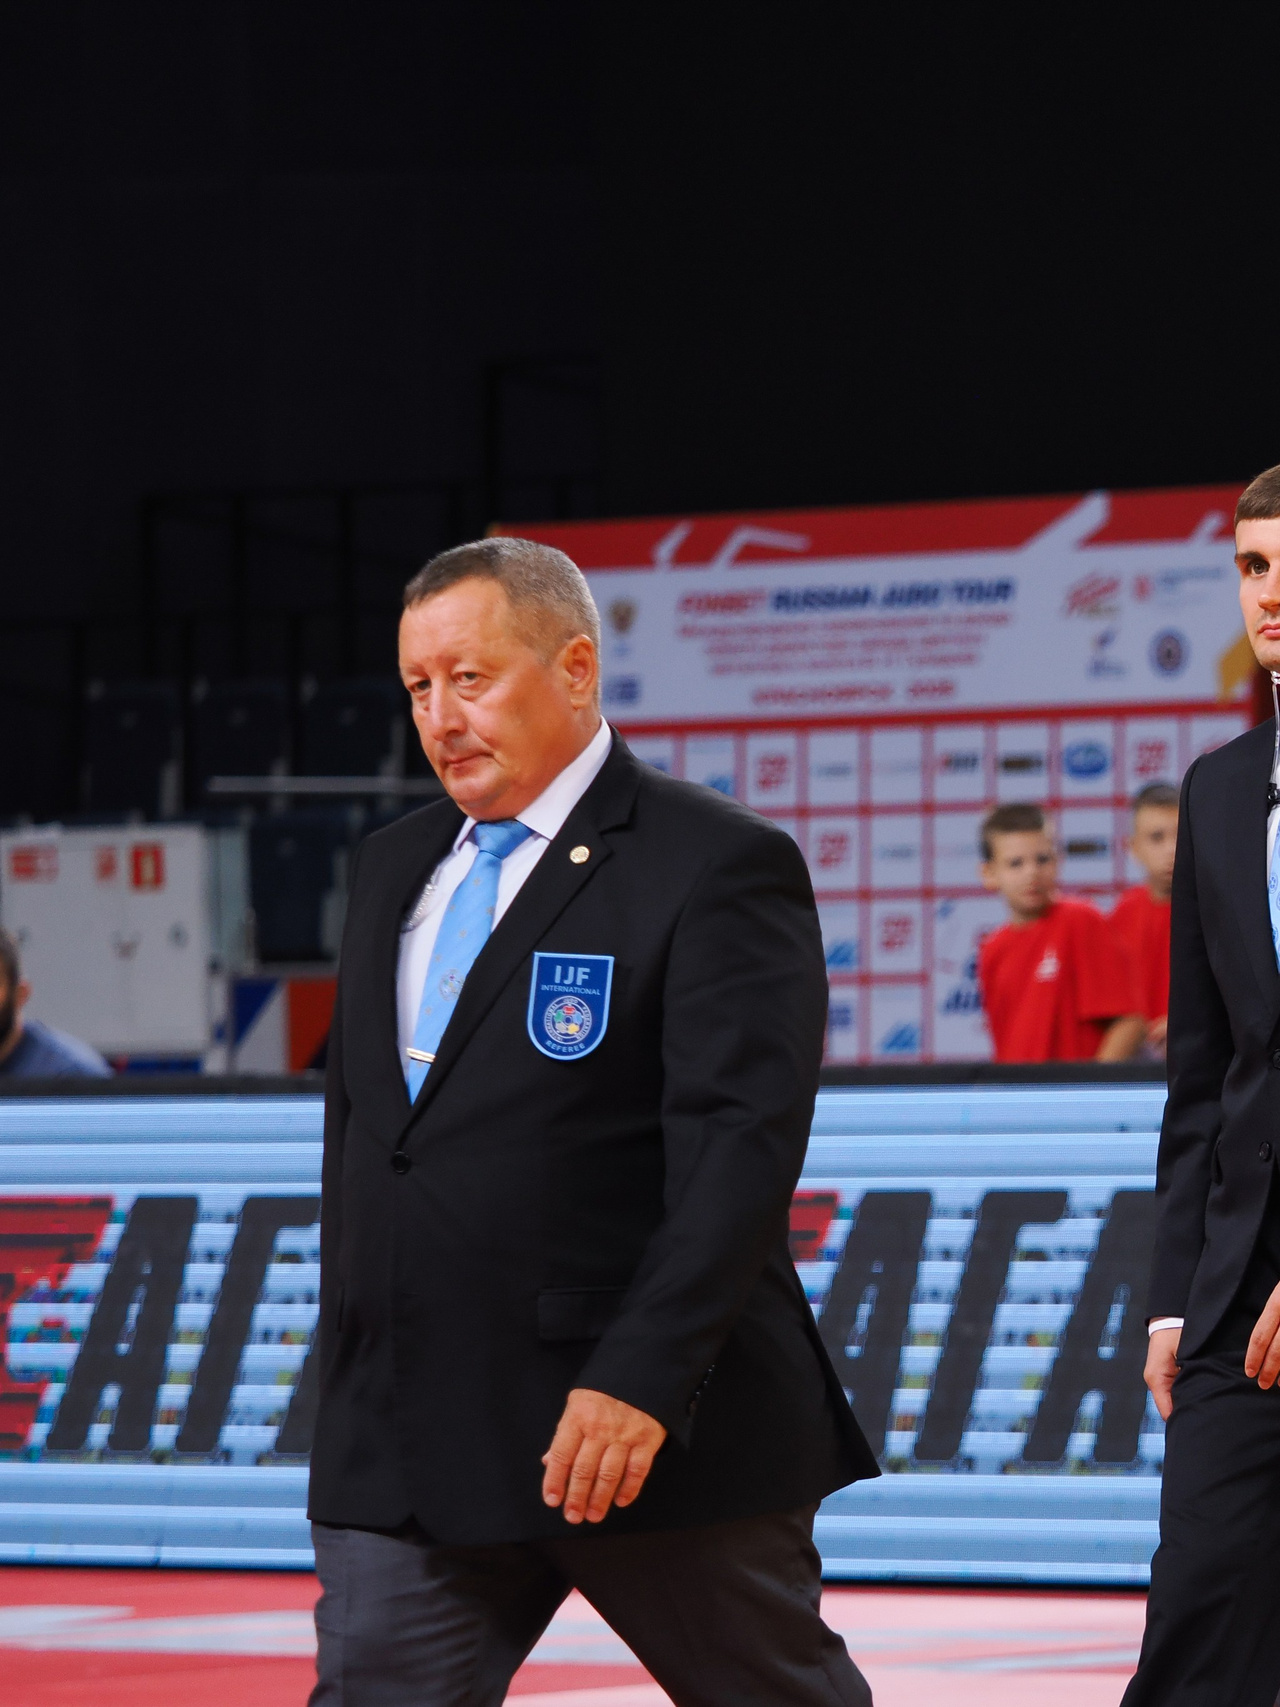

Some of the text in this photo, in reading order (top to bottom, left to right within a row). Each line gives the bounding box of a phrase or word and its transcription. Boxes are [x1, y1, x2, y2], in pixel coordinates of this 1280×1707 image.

[554, 965, 591, 986] IJF
[541, 984, 601, 996] INTERNATIONAL
[545, 1039, 586, 1053] REFEREE
